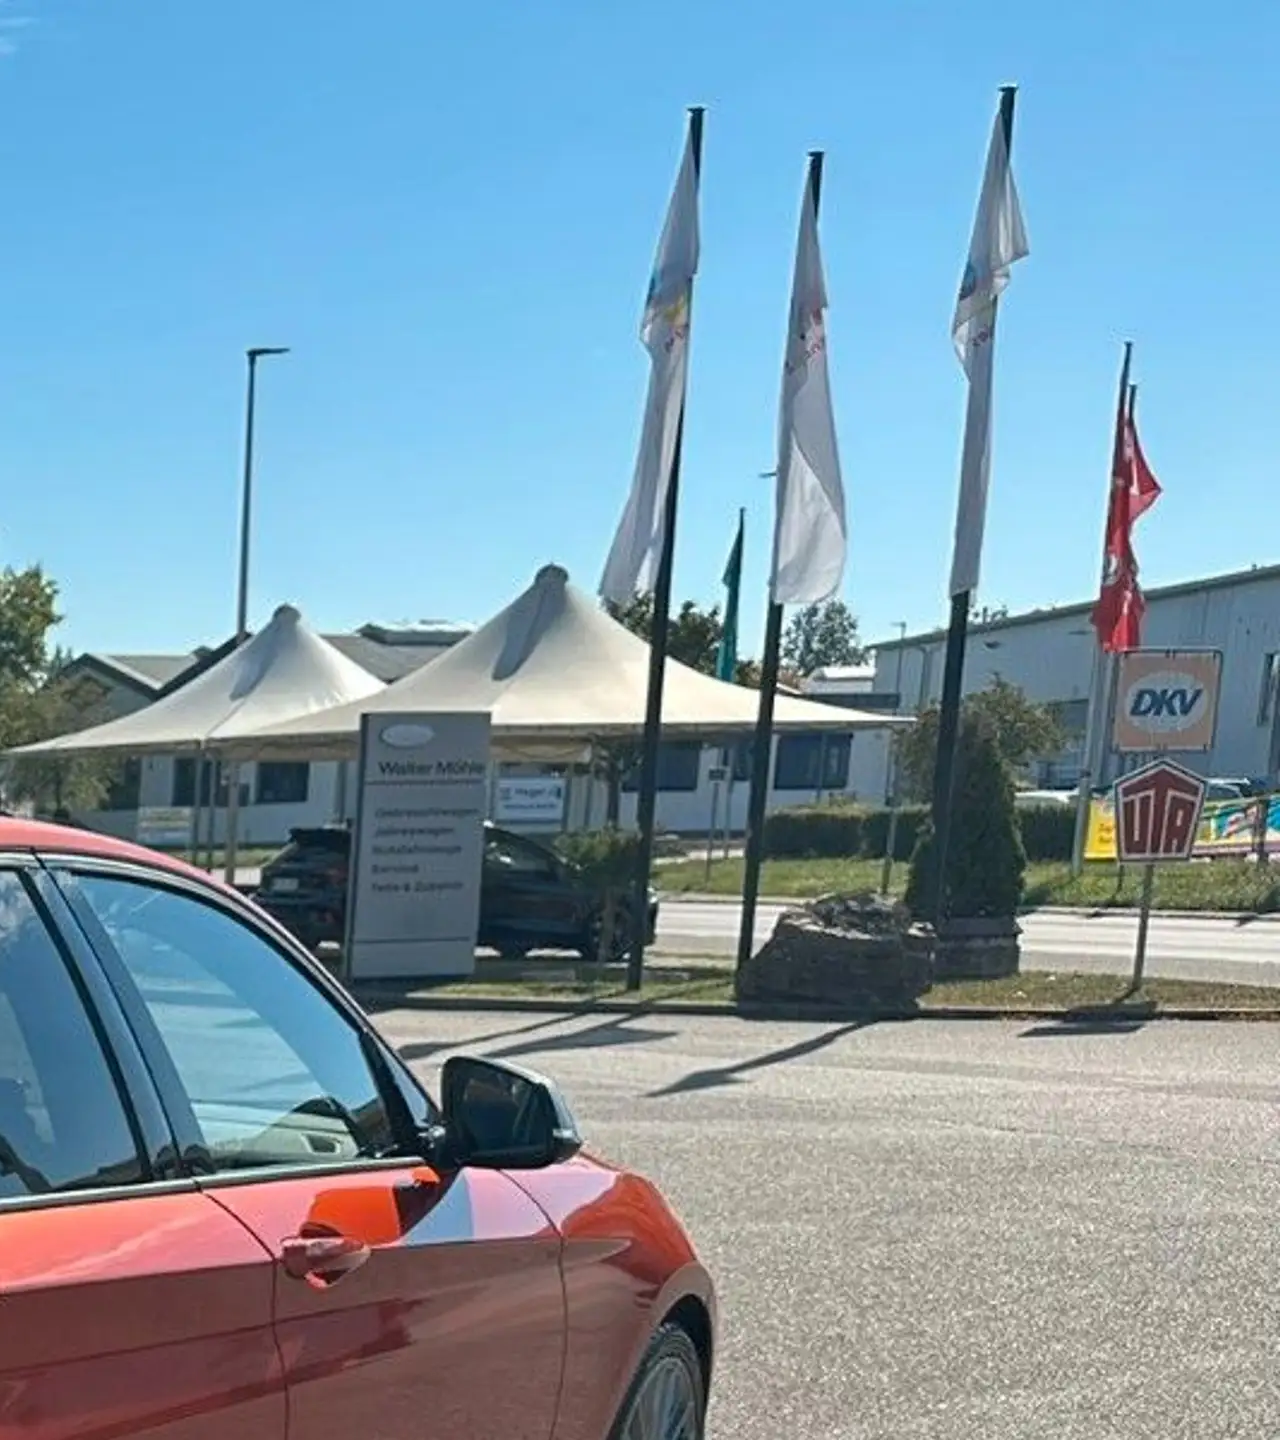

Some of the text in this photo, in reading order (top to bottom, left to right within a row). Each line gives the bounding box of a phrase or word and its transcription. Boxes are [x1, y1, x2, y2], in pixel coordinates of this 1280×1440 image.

[1129, 687, 1204, 717] DKV
[377, 760, 434, 776] Walter
[1120, 766, 1202, 856] UTA
